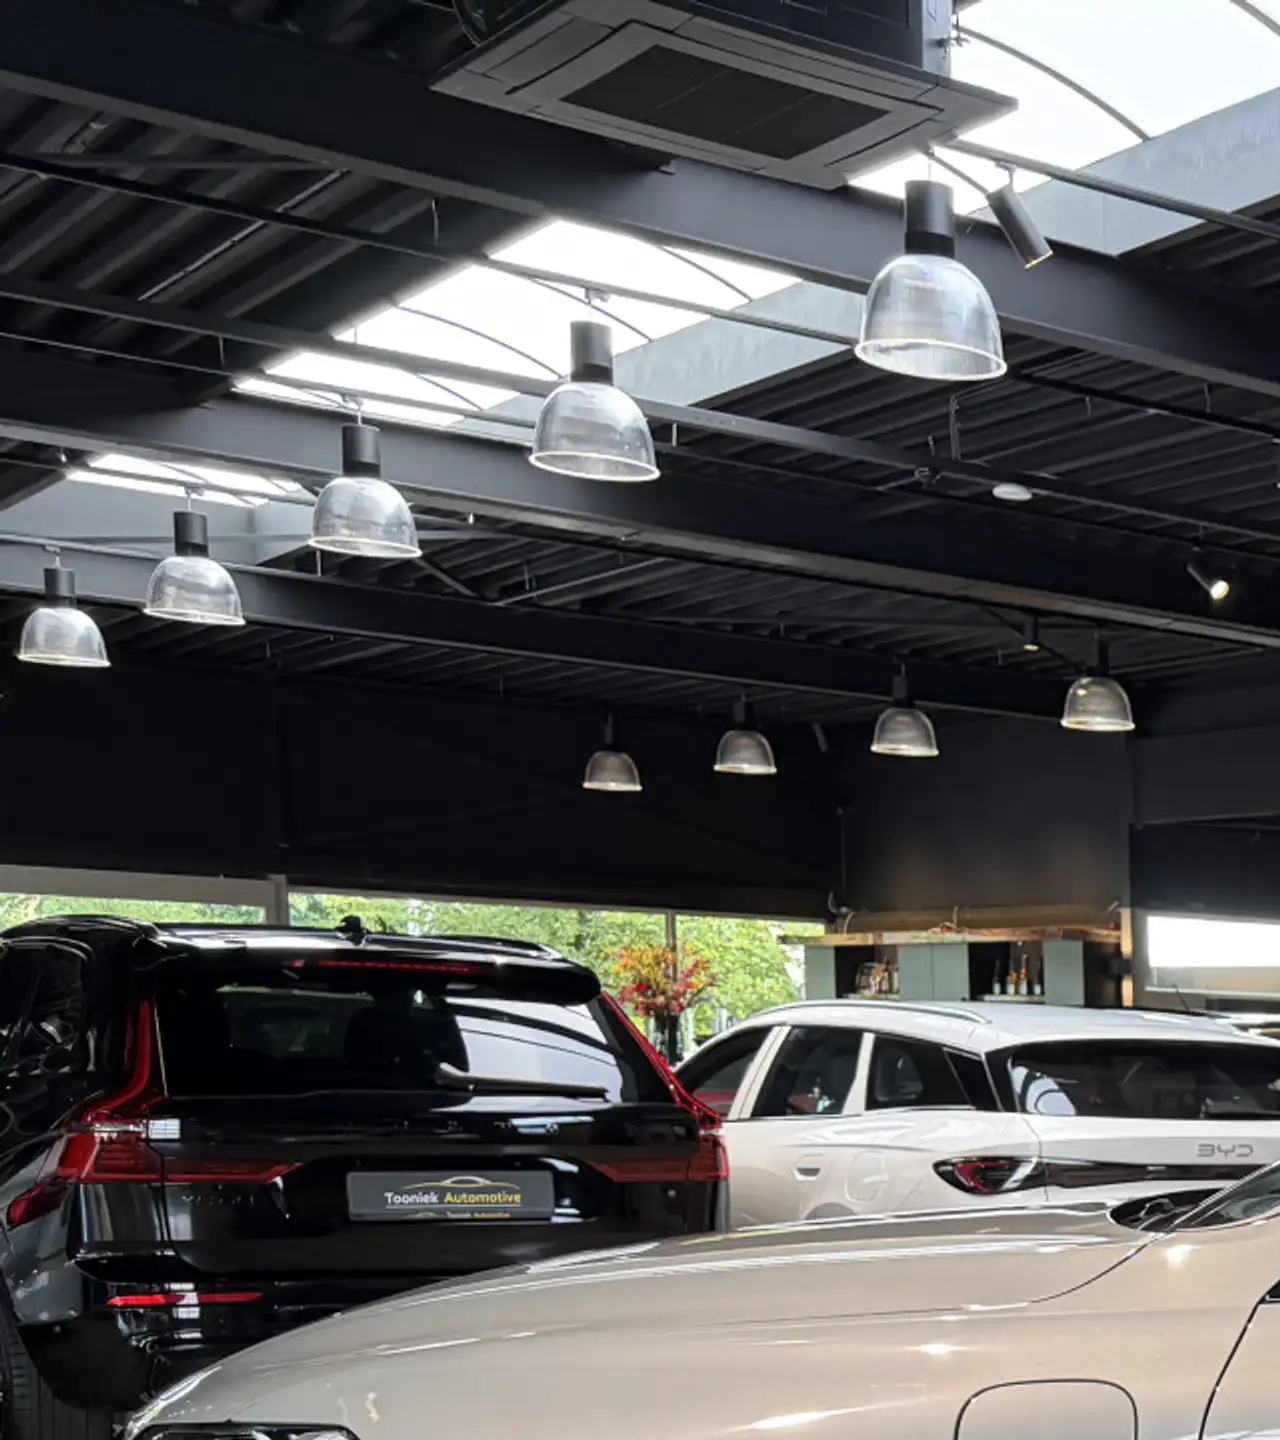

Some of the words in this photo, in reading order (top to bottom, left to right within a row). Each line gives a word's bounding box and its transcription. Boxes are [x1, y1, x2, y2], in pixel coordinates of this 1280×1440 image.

[1196, 1143, 1254, 1160] BYD
[383, 1192, 439, 1204] Tooniek
[444, 1189, 521, 1204] Automotive
